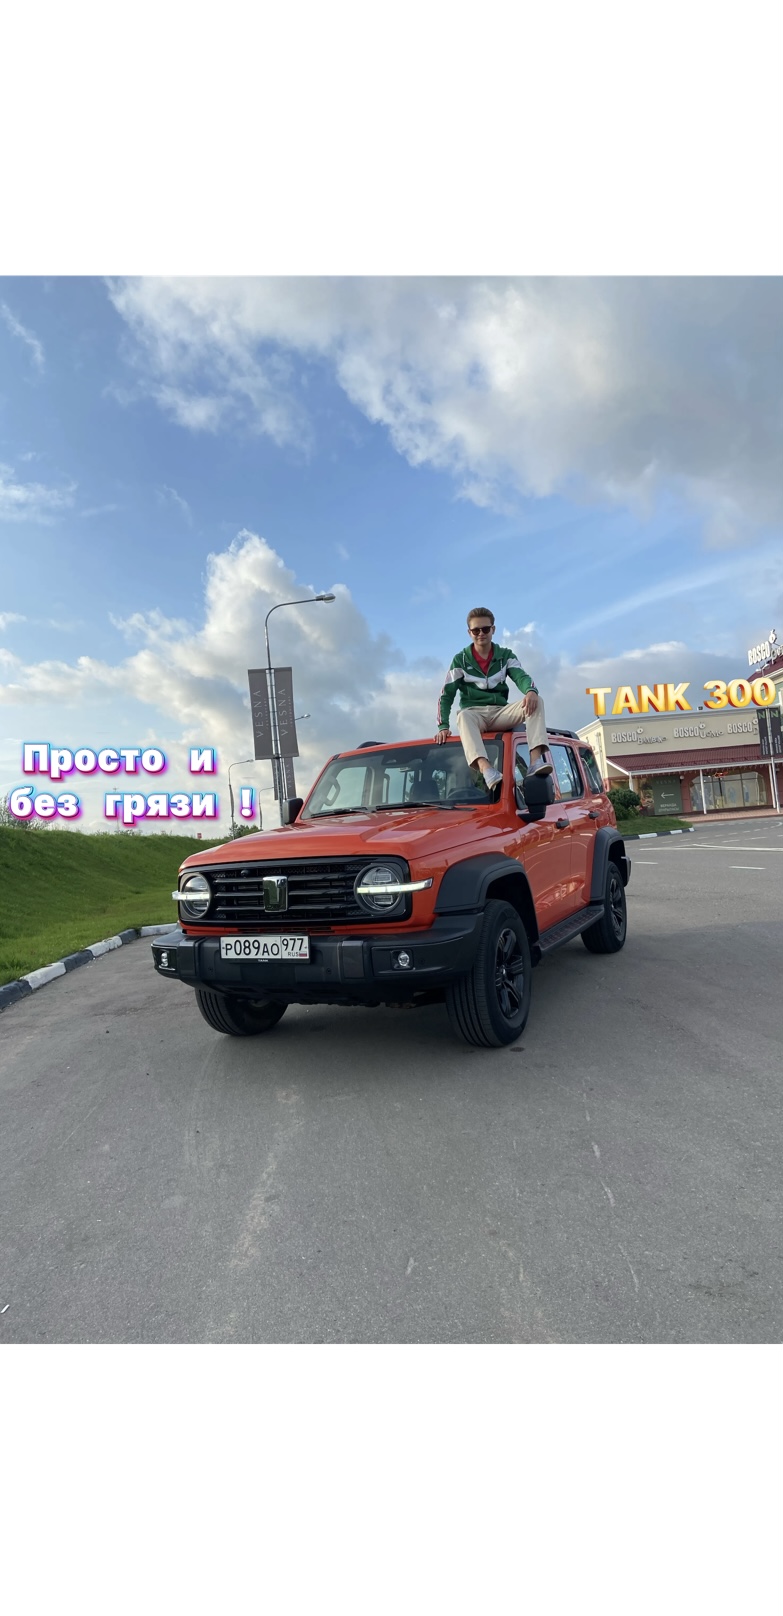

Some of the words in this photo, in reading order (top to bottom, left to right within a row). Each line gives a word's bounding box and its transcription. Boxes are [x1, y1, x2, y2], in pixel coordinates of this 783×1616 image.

[747, 640, 771, 666] BOSCO
[253, 690, 264, 738] VESNA
[278, 688, 288, 736] VESNA
[673, 726, 699, 738] BOSCO
[727, 722, 753, 734] BOSCO
[611, 731, 637, 743] BOSCO
[282, 938, 304, 951] 977
